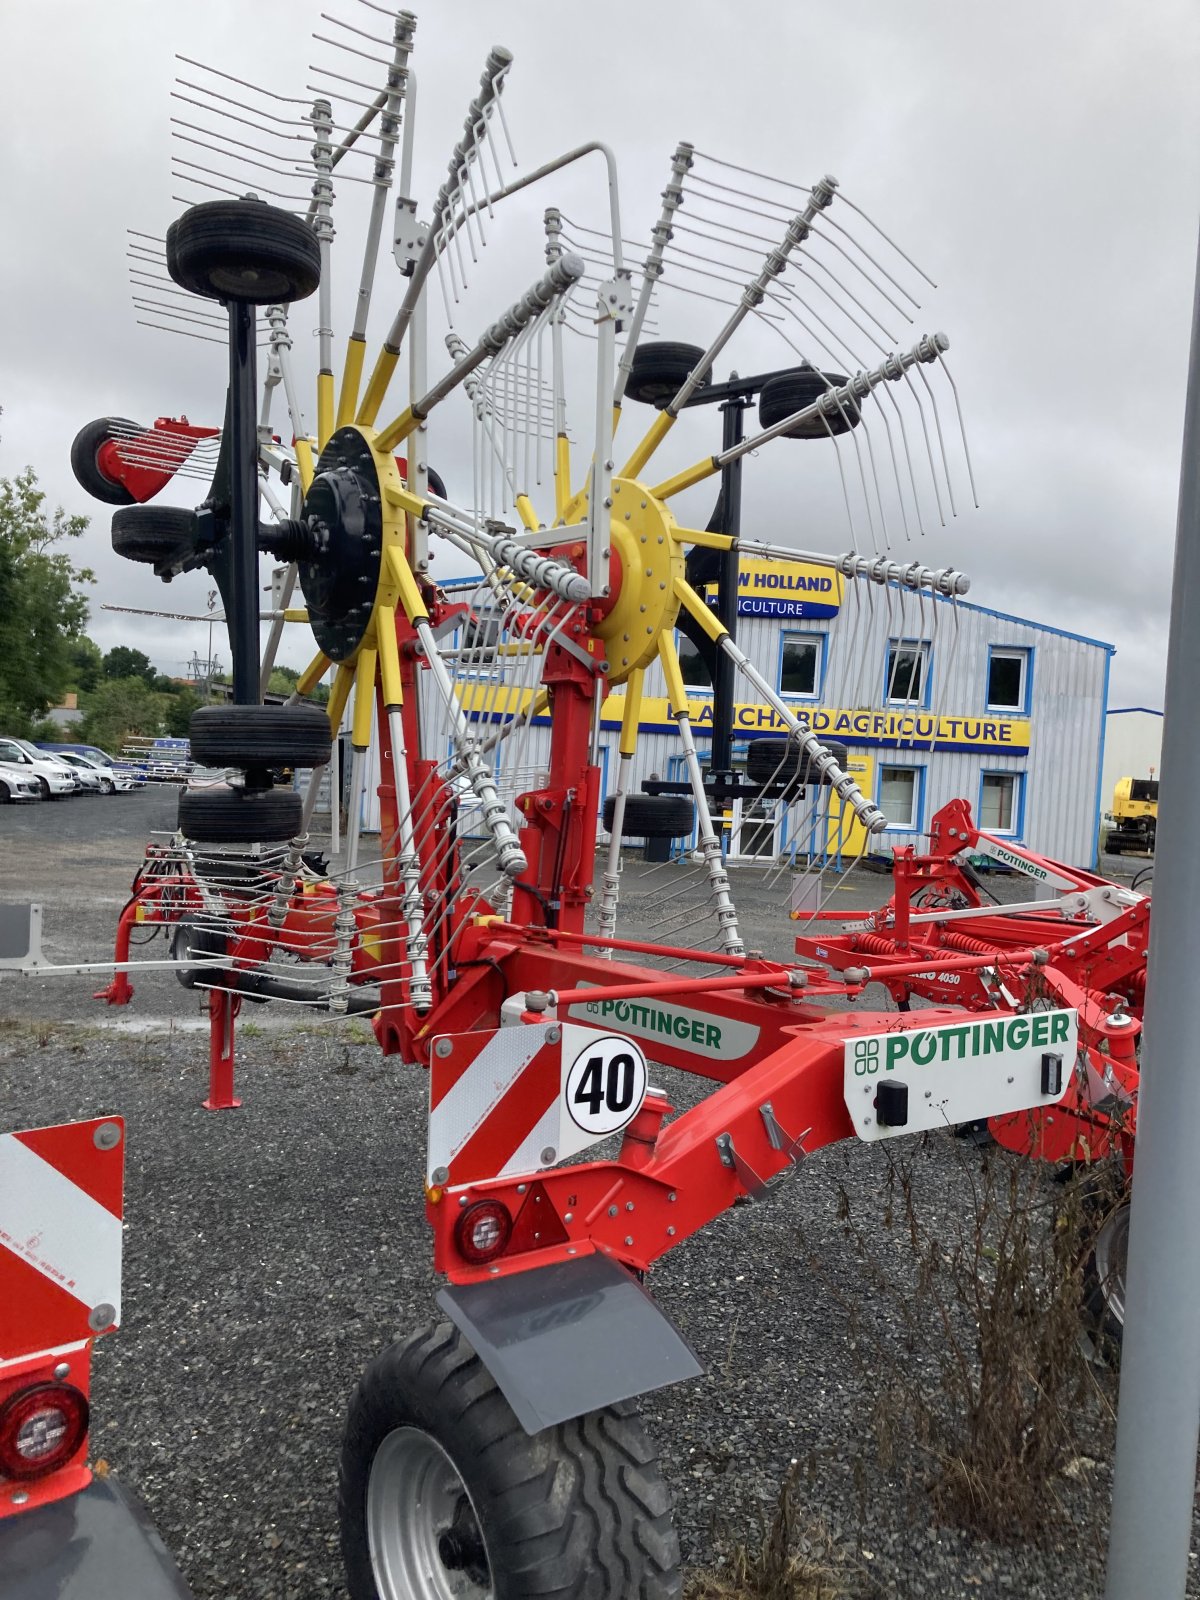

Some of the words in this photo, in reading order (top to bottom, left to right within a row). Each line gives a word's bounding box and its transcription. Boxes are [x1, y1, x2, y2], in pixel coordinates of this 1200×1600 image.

[754, 573, 832, 592] HOLLAND
[835, 713, 1012, 742] AGRICULTURE
[937, 972, 960, 985] 4030
[602, 999, 722, 1049] PÖTTINGER
[885, 1013, 1070, 1071] PÖTTINGER
[573, 1053, 635, 1115] 40
